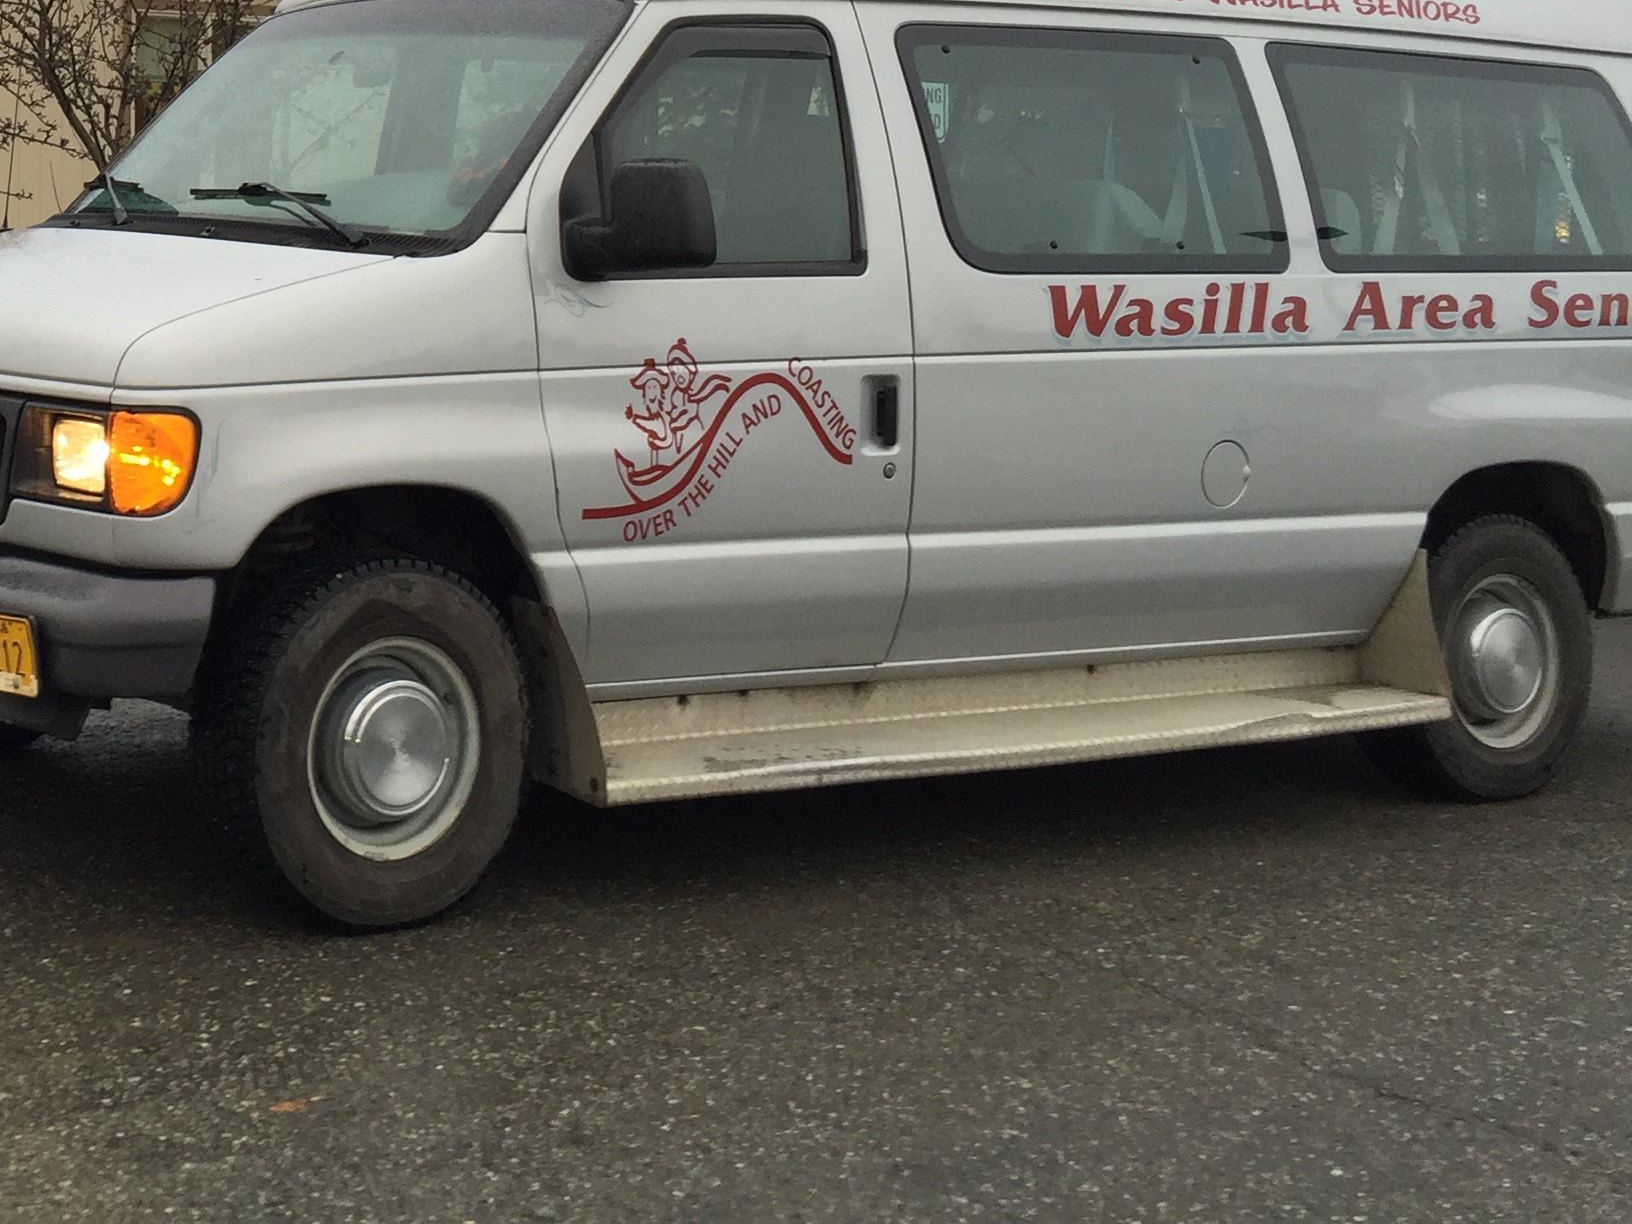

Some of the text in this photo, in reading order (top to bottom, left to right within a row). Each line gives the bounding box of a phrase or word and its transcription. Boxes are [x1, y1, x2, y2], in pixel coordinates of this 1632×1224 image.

[1048, 279, 1629, 338] Wasilla Area Sen
[623, 357, 857, 542] OVER THE HILL AND COASTING
